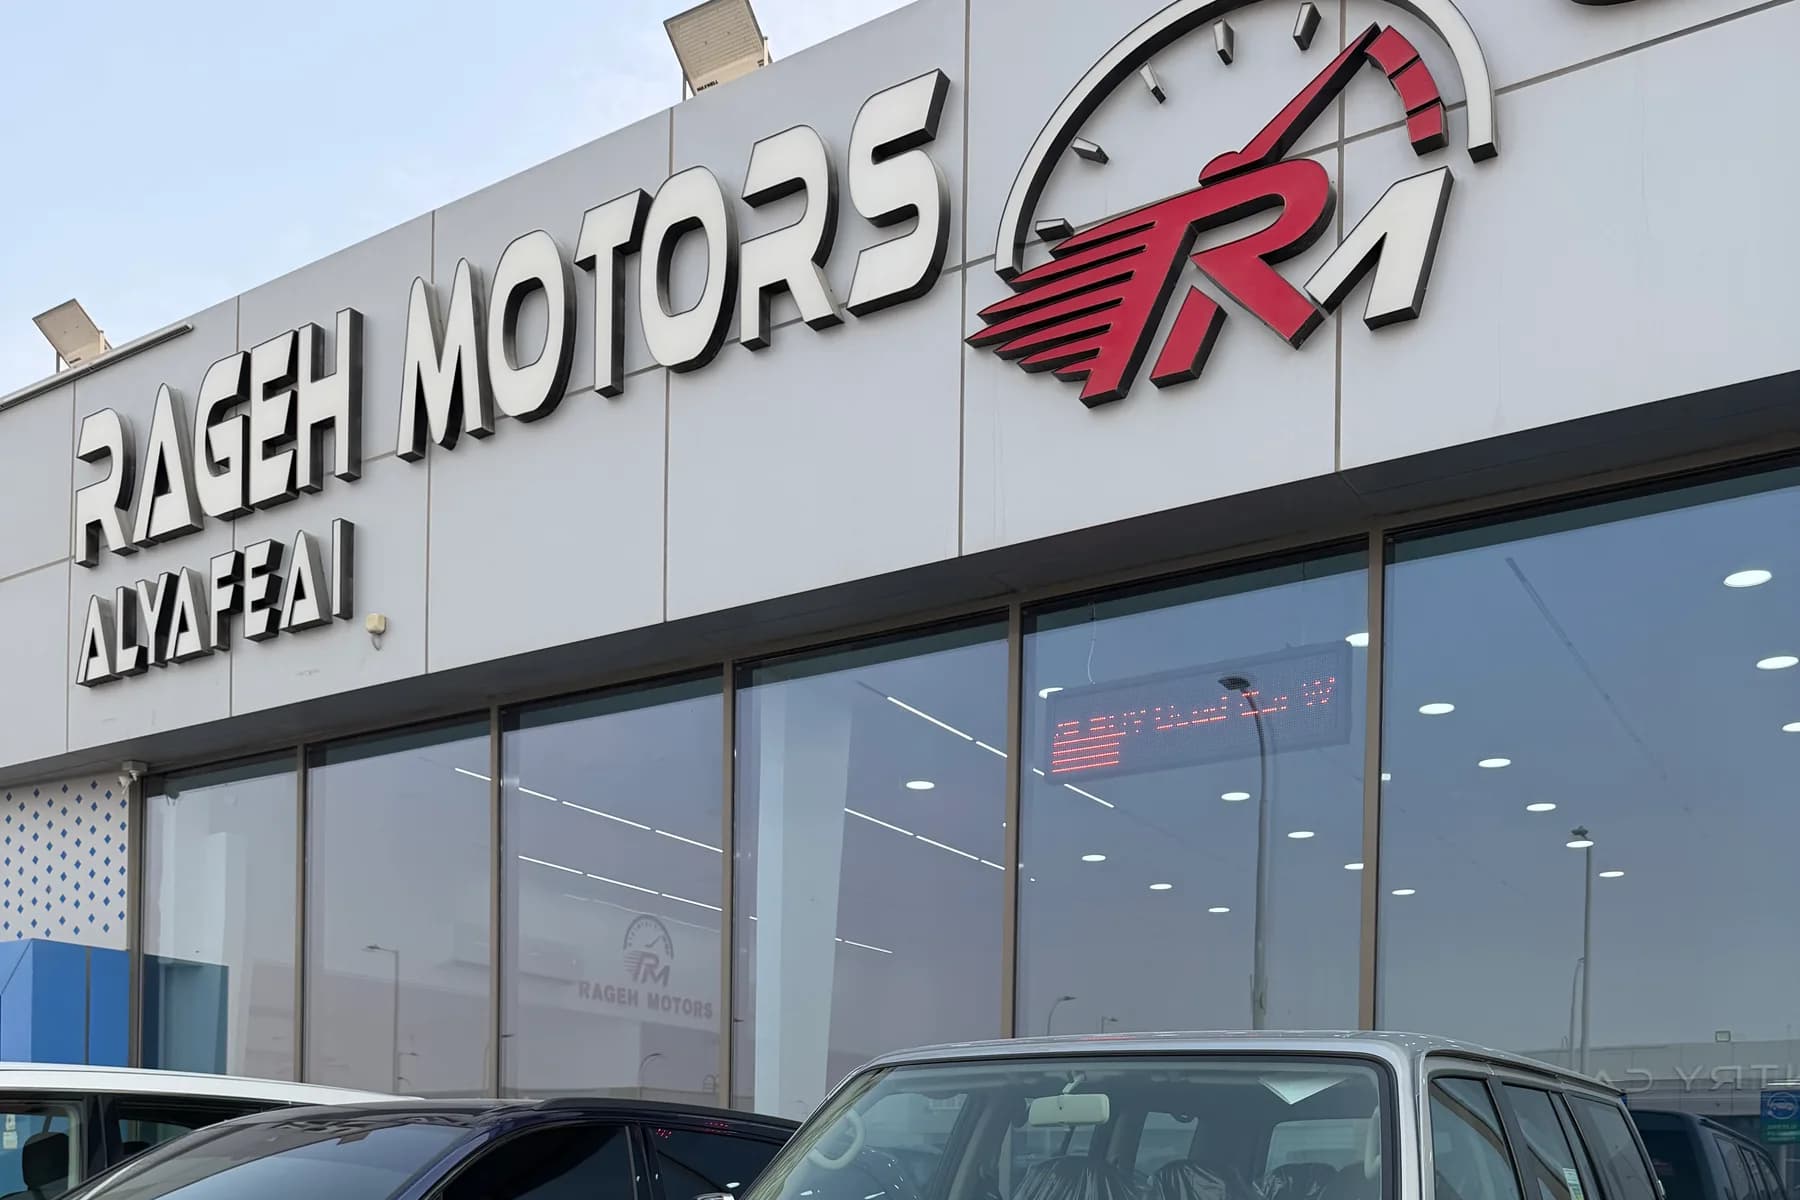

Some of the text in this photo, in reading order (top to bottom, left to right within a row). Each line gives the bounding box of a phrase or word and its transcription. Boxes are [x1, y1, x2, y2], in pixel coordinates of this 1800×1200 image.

[75, 70, 950, 567] RAGEH MOTORS
[76, 518, 354, 688] ALYAFEAI
[578, 980, 713, 1019] RAGEH MOTORS
